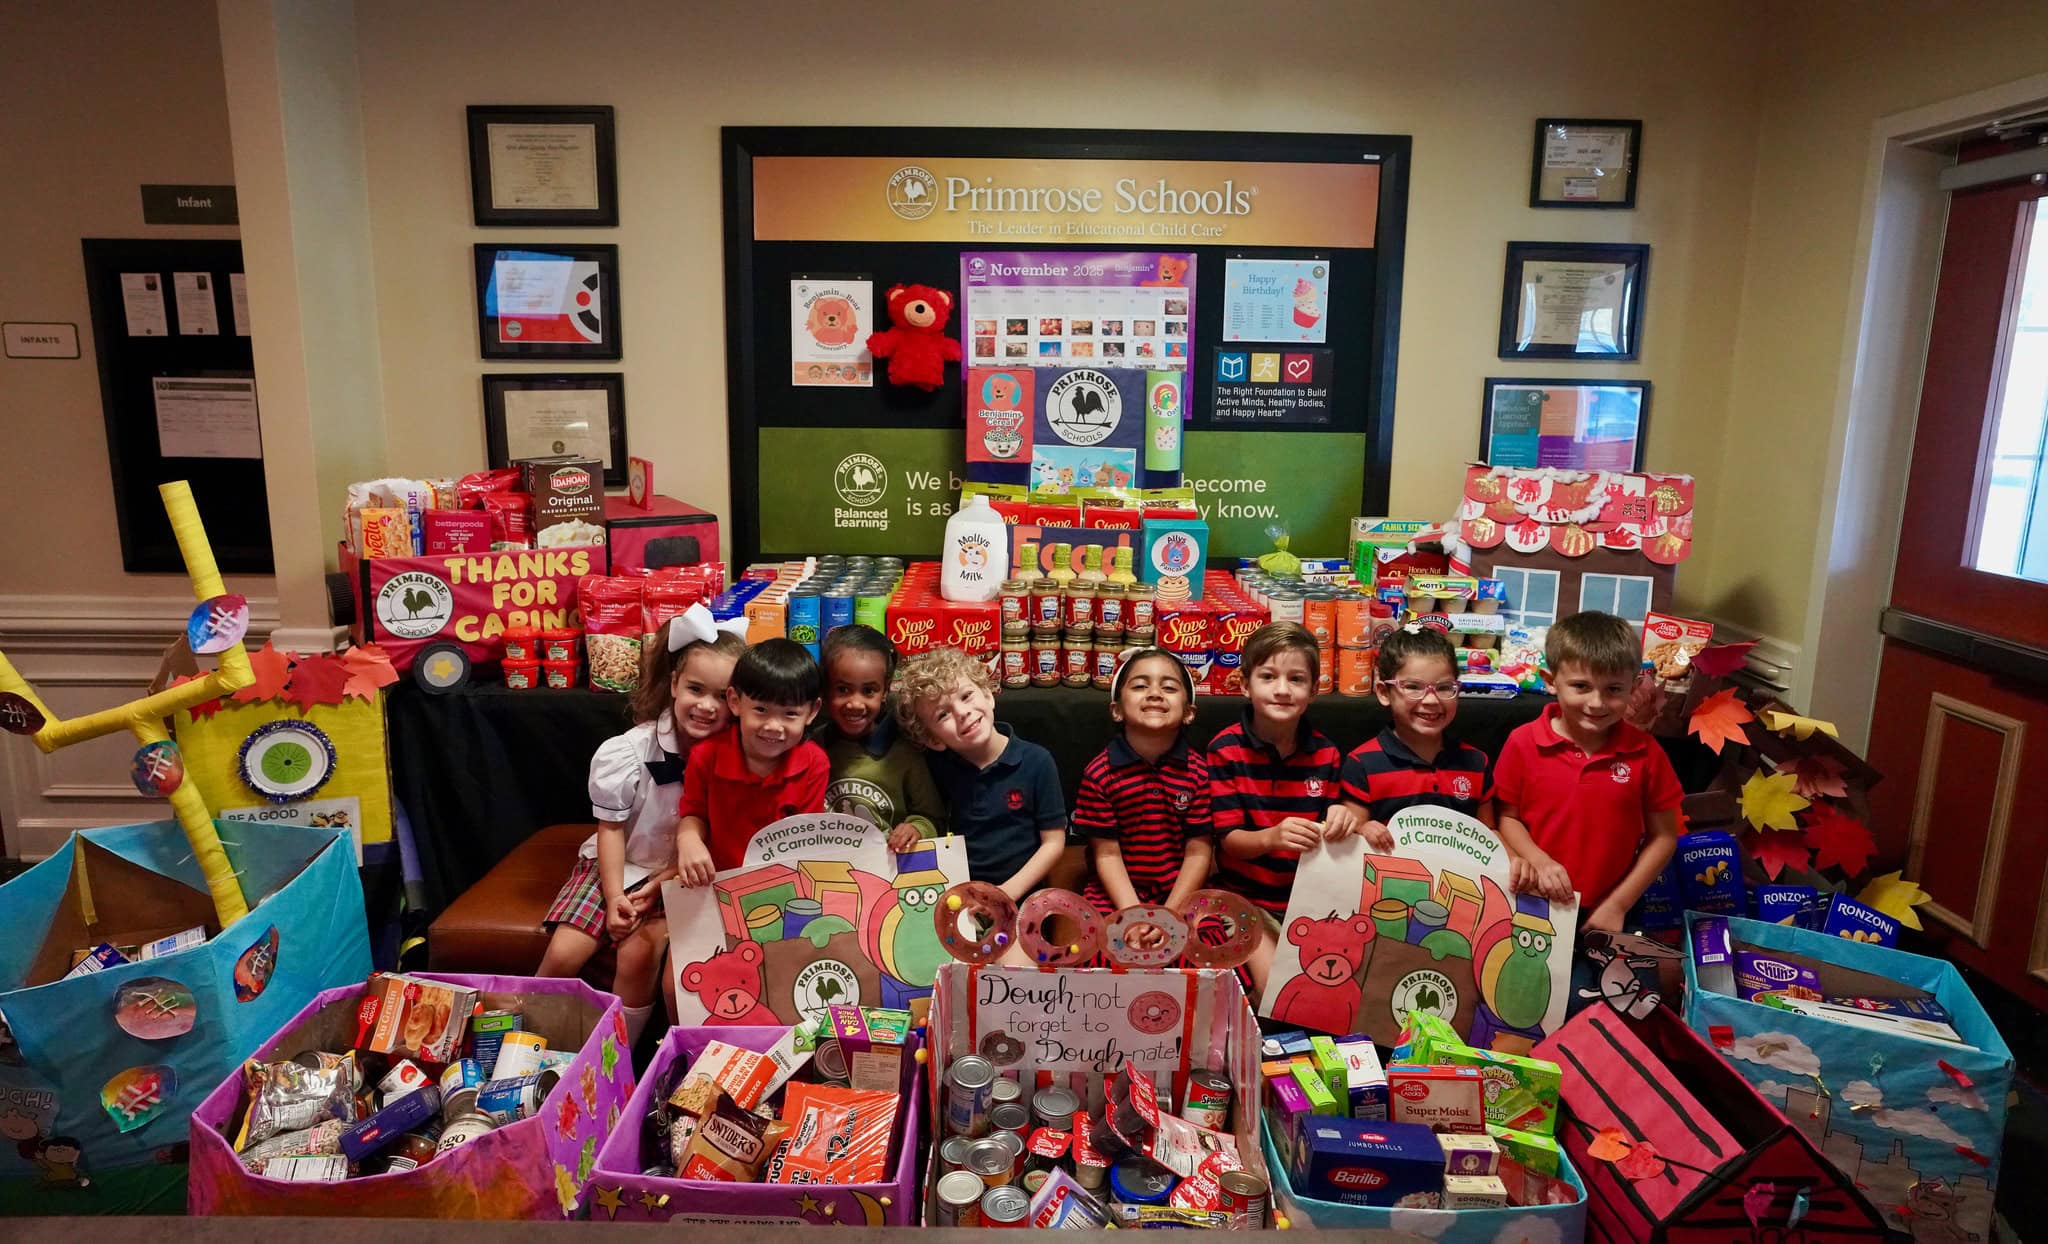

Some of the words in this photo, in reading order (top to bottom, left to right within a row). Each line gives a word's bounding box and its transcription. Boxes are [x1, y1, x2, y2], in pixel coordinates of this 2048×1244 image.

[891, 168, 934, 187] PRIMROSE
[177, 196, 212, 209] Infant
[944, 176, 1102, 213] Primrose
[968, 220, 994, 235] The
[997, 221, 1044, 236] Leader
[1048, 222, 1061, 236] in
[1065, 222, 1146, 237] Educational
[1149, 222, 1187, 237] Child
[990, 263, 1068, 277] November
[1073, 264, 1104, 277] 2025
[1248, 275, 1277, 286] Happy
[803, 287, 840, 309] Benjamin
[846, 293, 861, 312] Bear
[1242, 286, 1285, 297] Birthday!
[20, 335, 60, 345] INFANTS
[1052, 371, 1118, 399] PRIMROSE
[1217, 387, 1231, 396] The
[1233, 387, 1253, 399] Right
[1255, 387, 1296, 397] Foundation
[1298, 389, 1306, 397] to
[1307, 388, 1327, 397] Build
[1216, 397, 1240, 407] Active
[1242, 398, 1266, 408] Minds,
[1268, 398, 1296, 411] Healthy
[1298, 399, 1326, 409] Bodies,
[978, 409, 1024, 419] Benjamins
[986, 417, 1013, 426] Cereal
[1216, 408, 1230, 417] and
[1232, 409, 1256, 420] Happy
[1062, 429, 1104, 443] SCHOOLS
[839, 456, 884, 474] PRIMROSE
[552, 474, 588, 488] IDAHOAN
[905, 471, 941, 490] We
[1181, 472, 1267, 493] become
[548, 495, 593, 507] Original
[846, 495, 876, 504] SCHOOLS
[906, 497, 922, 516] is
[929, 502, 953, 516] as
[834, 508, 888, 519] Balanced
[1218, 498, 1279, 519] know.
[435, 519, 484, 528] bettergoods
[834, 518, 889, 531] Learning
[1381, 522, 1407, 531] FAMILY
[957, 533, 991, 548] Mollys
[1167, 535, 1187, 545] Allys
[444, 551, 591, 585] THANKS
[959, 570, 983, 582] Milk
[1160, 562, 1191, 574] Pancakes
[1408, 566, 1427, 576] Honey
[1429, 567, 1441, 575] Nut
[381, 574, 448, 600] PRIMROSE
[492, 580, 558, 610] FOR
[395, 622, 439, 637] SCHOOLS
[891, 617, 936, 644] Stove
[947, 618, 992, 646] Stove
[1163, 617, 1208, 644] Stove
[1220, 618, 1263, 645] Stove
[1660, 622, 1679, 632] Betty
[906, 633, 929, 651] Top
[963, 635, 986, 652] Top
[1179, 633, 1201, 650] Top
[824, 782, 889, 812] PRIMROSE
[248, 811, 257, 822] A
[259, 809, 299, 821] GOOD
[755, 820, 816, 849] Primrose
[819, 820, 870, 835] School
[1397, 816, 1453, 833] Primrose
[1456, 820, 1499, 853] School
[762, 850, 775, 862] of
[777, 834, 863, 854] Carrollwood
[1399, 834, 1412, 847] of
[1414, 831, 1491, 866] Carrollwood
[1683, 847, 1733, 863] RONZONI
[1837, 902, 1894, 936] RONZONI
[798, 962, 854, 988] PRIMROSE
[979, 974, 1128, 1014] Dough-not
[1400, 973, 1455, 1001] PRIMROSE
[360, 999, 373, 1021] Betty
[366, 996, 379, 1025] Crocker
[382, 989, 398, 1022] Gratin
[376, 1023, 389, 1041] Au
[844, 1026, 862, 1036] 4
[1006, 1011, 1072, 1041] forget
[1084, 1013, 1109, 1033] to
[1036, 1037, 1182, 1073] Dough-nate!
[738, 1080, 762, 1109] Banza
[1400, 1089, 1427, 1098] Crocker
[1405, 1083, 1423, 1093] Betty
[1406, 1105, 1437, 1117] Super
[1439, 1106, 1469, 1116] Moist
[709, 1118, 757, 1156] SNYDER'S
[1362, 1133, 1386, 1141] Barilla
[826, 1134, 851, 1164] 12
[1348, 1141, 1373, 1149] JUMBO
[1374, 1143, 1403, 1151] SHELLS
[1333, 1171, 1382, 1185] Barilla
[1340, 1193, 1368, 1201] JUMBO
[1034, 1185, 1070, 1229] JELL-O
